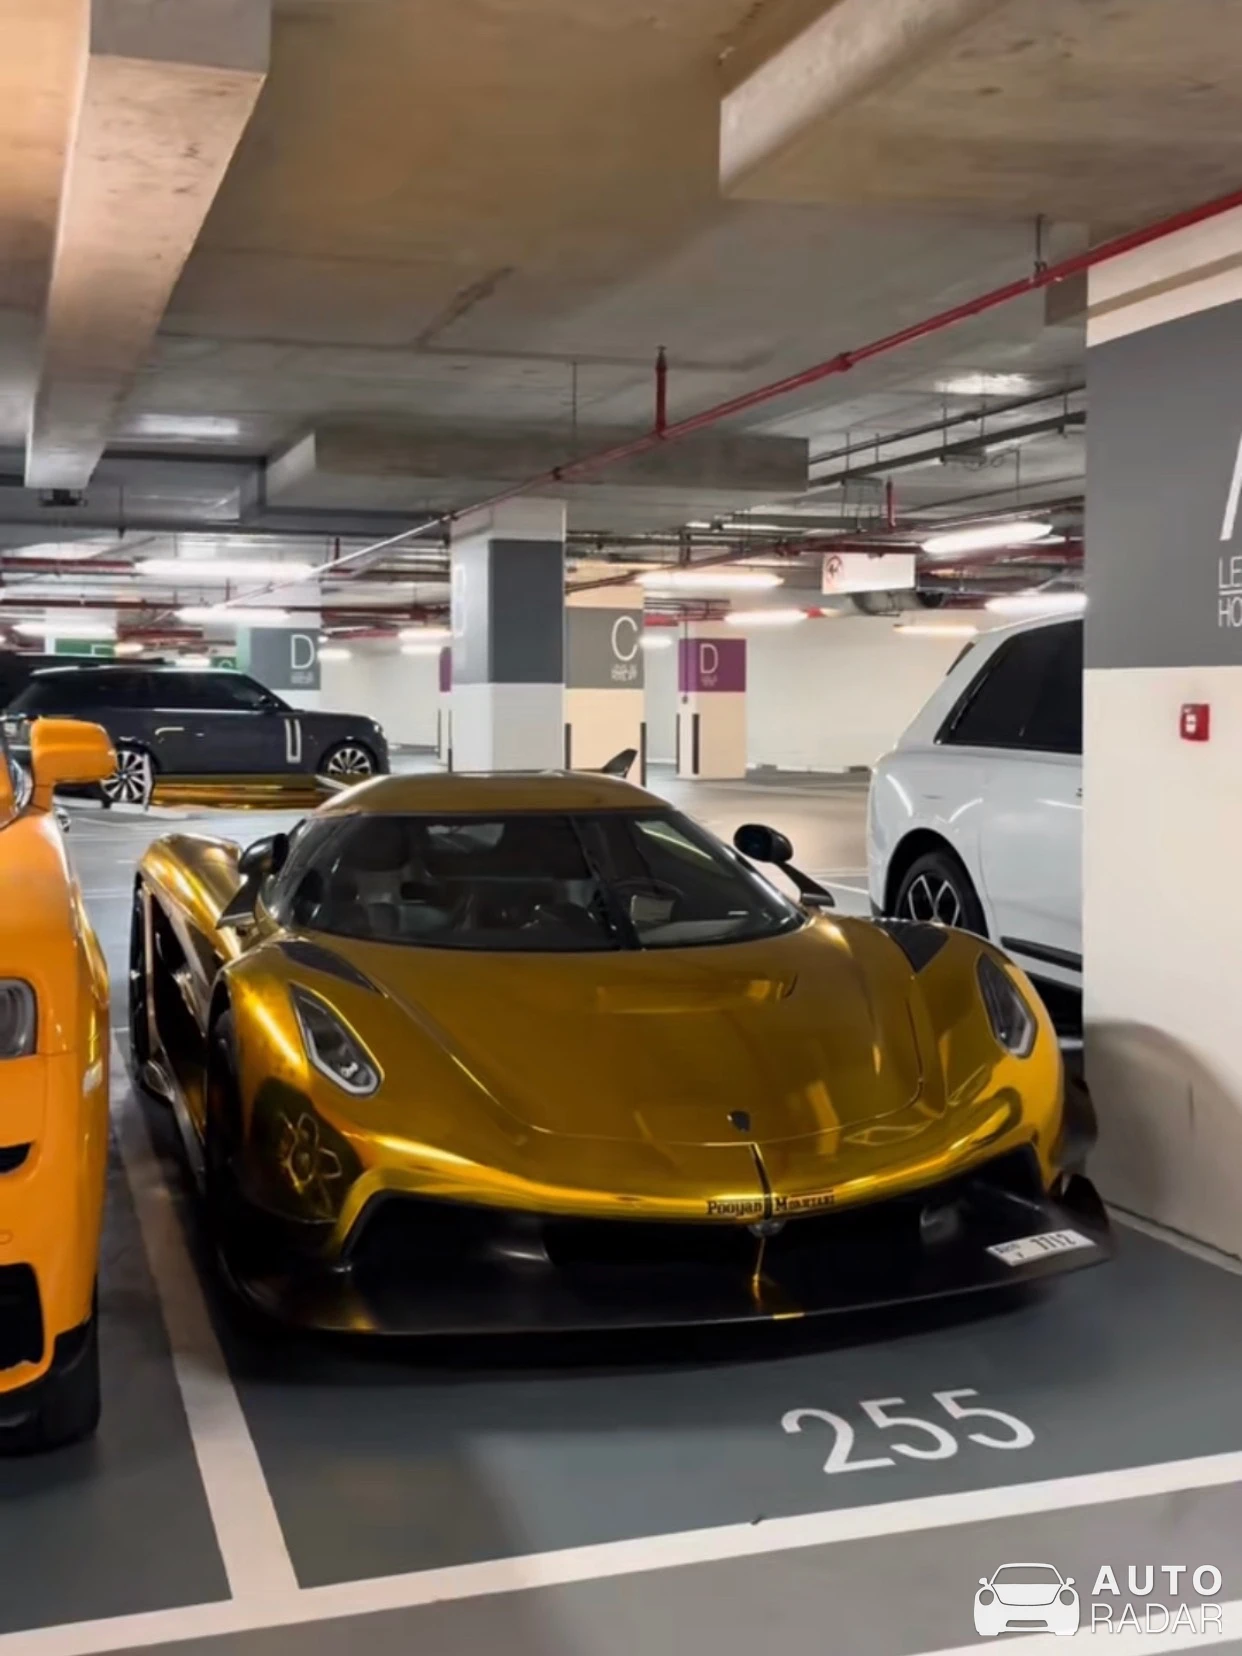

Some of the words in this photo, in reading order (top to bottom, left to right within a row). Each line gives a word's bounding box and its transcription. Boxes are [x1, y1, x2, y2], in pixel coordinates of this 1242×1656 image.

[291, 634, 315, 669] D
[611, 616, 639, 661] C
[700, 643, 719, 674] D
[781, 1388, 1036, 1474] 255
